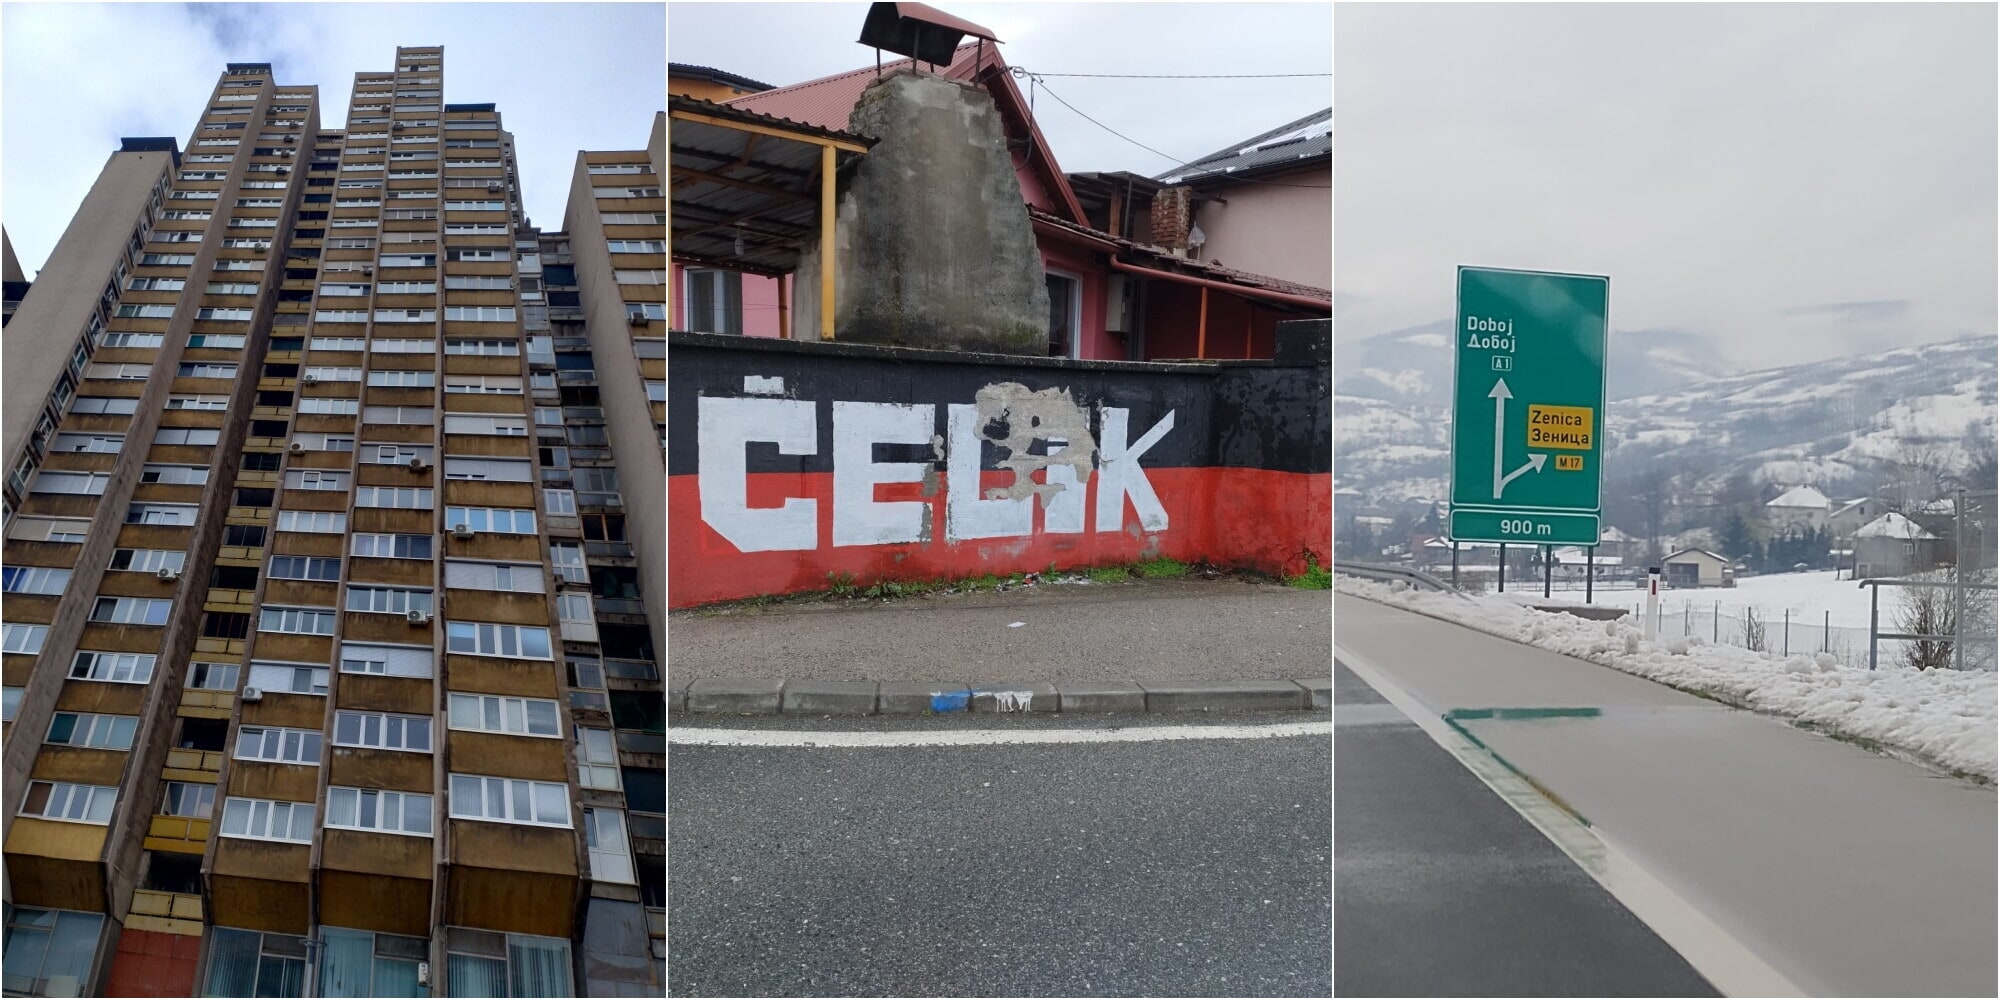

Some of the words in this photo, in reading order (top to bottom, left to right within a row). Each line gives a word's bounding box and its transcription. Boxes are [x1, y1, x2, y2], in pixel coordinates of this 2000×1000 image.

[1467, 316, 1513, 335] Doboj
[1467, 334, 1516, 353] Добој
[1532, 410, 1582, 426] Zenica
[1532, 428, 1589, 445] Зеница
[1501, 520, 1532, 535] 900
[1537, 523, 1551, 535] m
